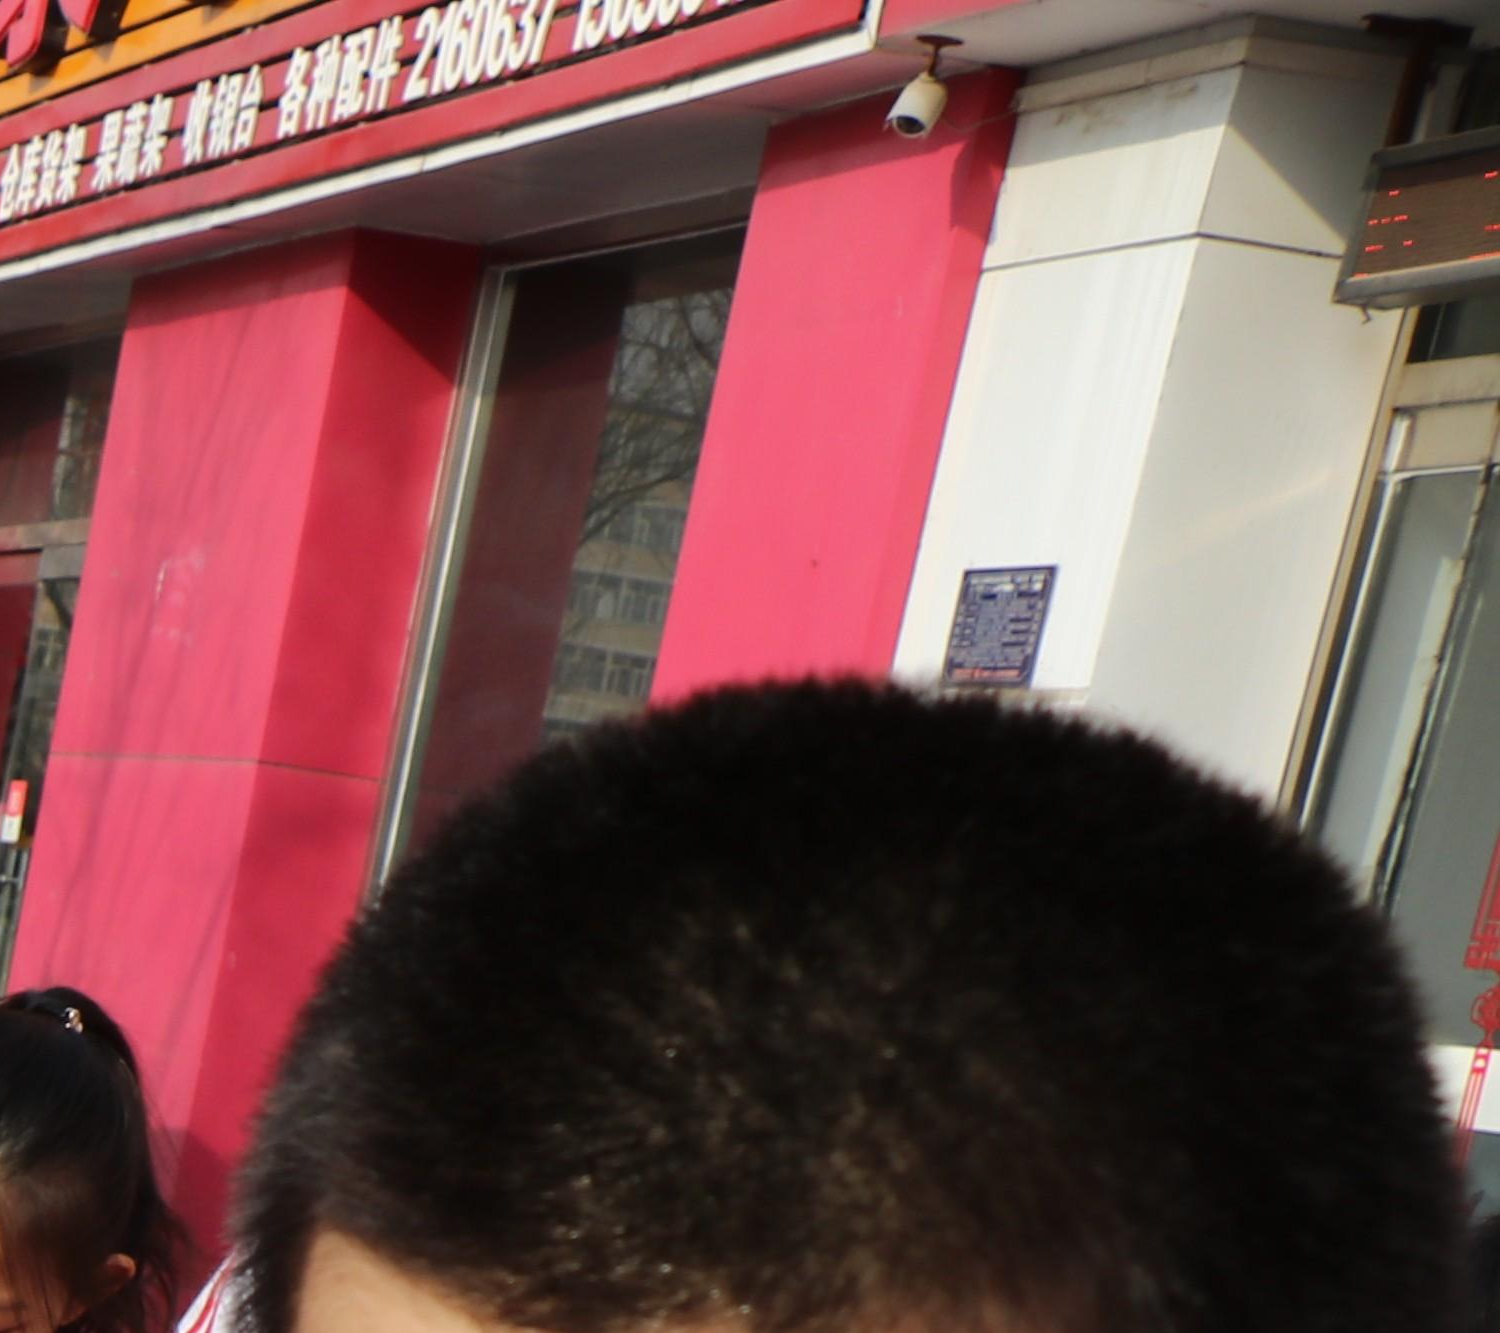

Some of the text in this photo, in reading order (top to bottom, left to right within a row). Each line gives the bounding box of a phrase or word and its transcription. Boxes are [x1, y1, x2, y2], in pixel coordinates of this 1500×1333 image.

[91, 93, 173, 189] 果蔬架
[181, 65, 263, 164] 收银台
[276, 14, 404, 140] 各种配件
[402, 0, 555, 102] 2160637
